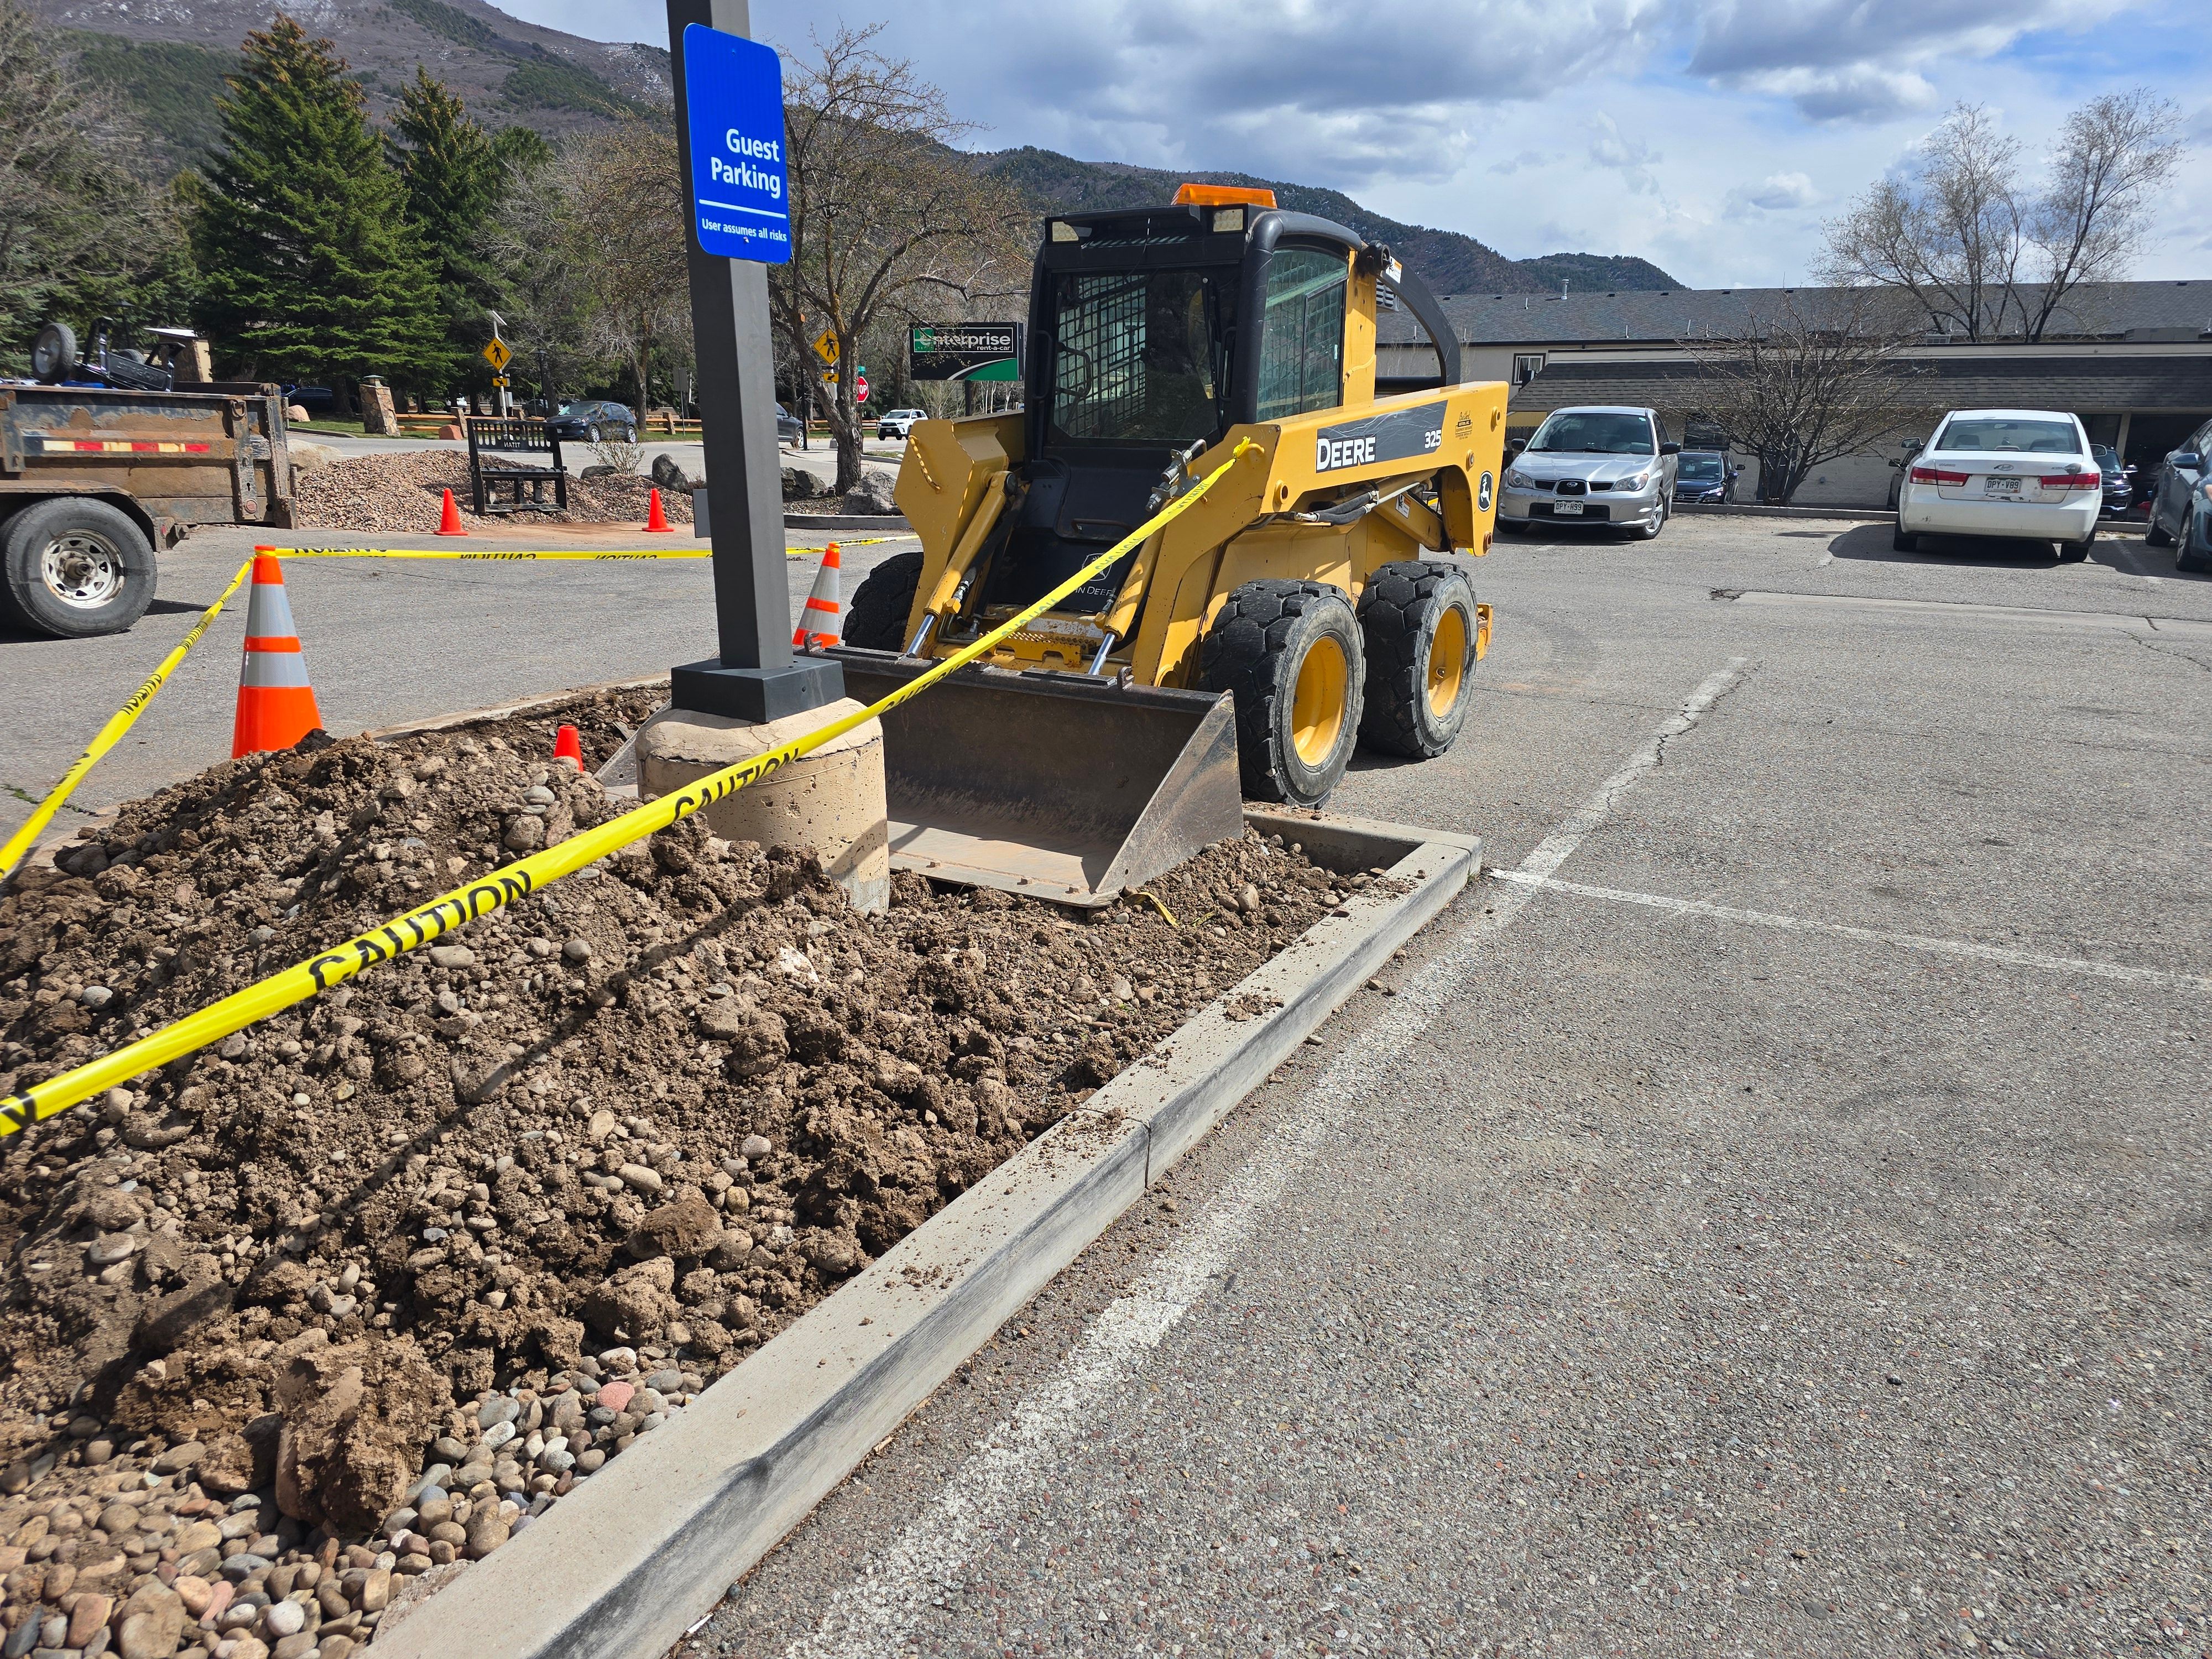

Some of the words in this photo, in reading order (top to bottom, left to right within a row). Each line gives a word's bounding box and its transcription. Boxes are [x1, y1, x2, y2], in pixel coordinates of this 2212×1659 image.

[726, 128, 779, 162] Guest
[711, 157, 781, 199] Parking
[702, 218, 721, 232] User
[723, 222, 757, 238] assumes
[758, 227, 768, 239] all
[769, 228, 787, 242] risks
[920, 332, 1010, 348] enterprise
[1316, 436, 1376, 471] DEERE
[1425, 429, 1442, 448] 325
[674, 748, 799, 821] CAUTION
[308, 870, 533, 992] CAUTION
